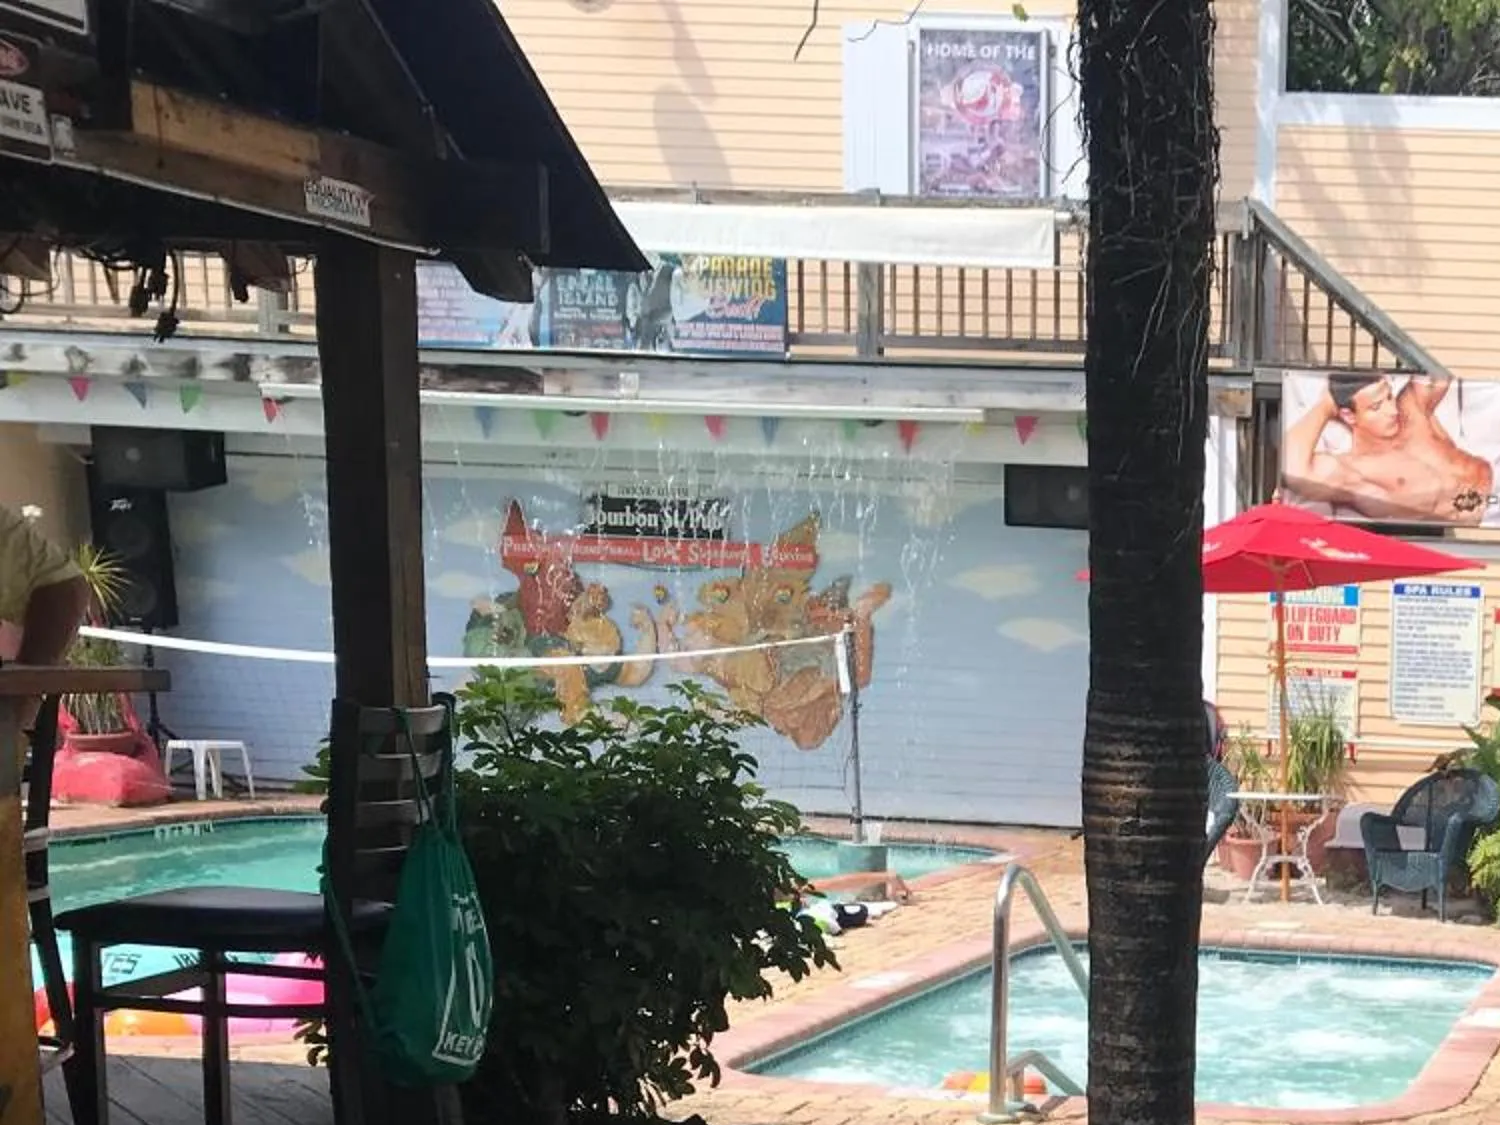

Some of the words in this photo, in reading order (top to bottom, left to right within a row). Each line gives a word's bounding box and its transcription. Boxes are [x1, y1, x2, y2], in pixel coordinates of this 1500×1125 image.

[927, 42, 976, 58] HOME
[979, 44, 1001, 58] OF
[1006, 44, 1036, 59] THE
[1405, 585, 1427, 596] SPA
[1431, 585, 1472, 597] RULES
[1291, 606, 1357, 624] LIFEGUARD
[1287, 624, 1304, 641] ON
[1308, 624, 1341, 642] DUTY
